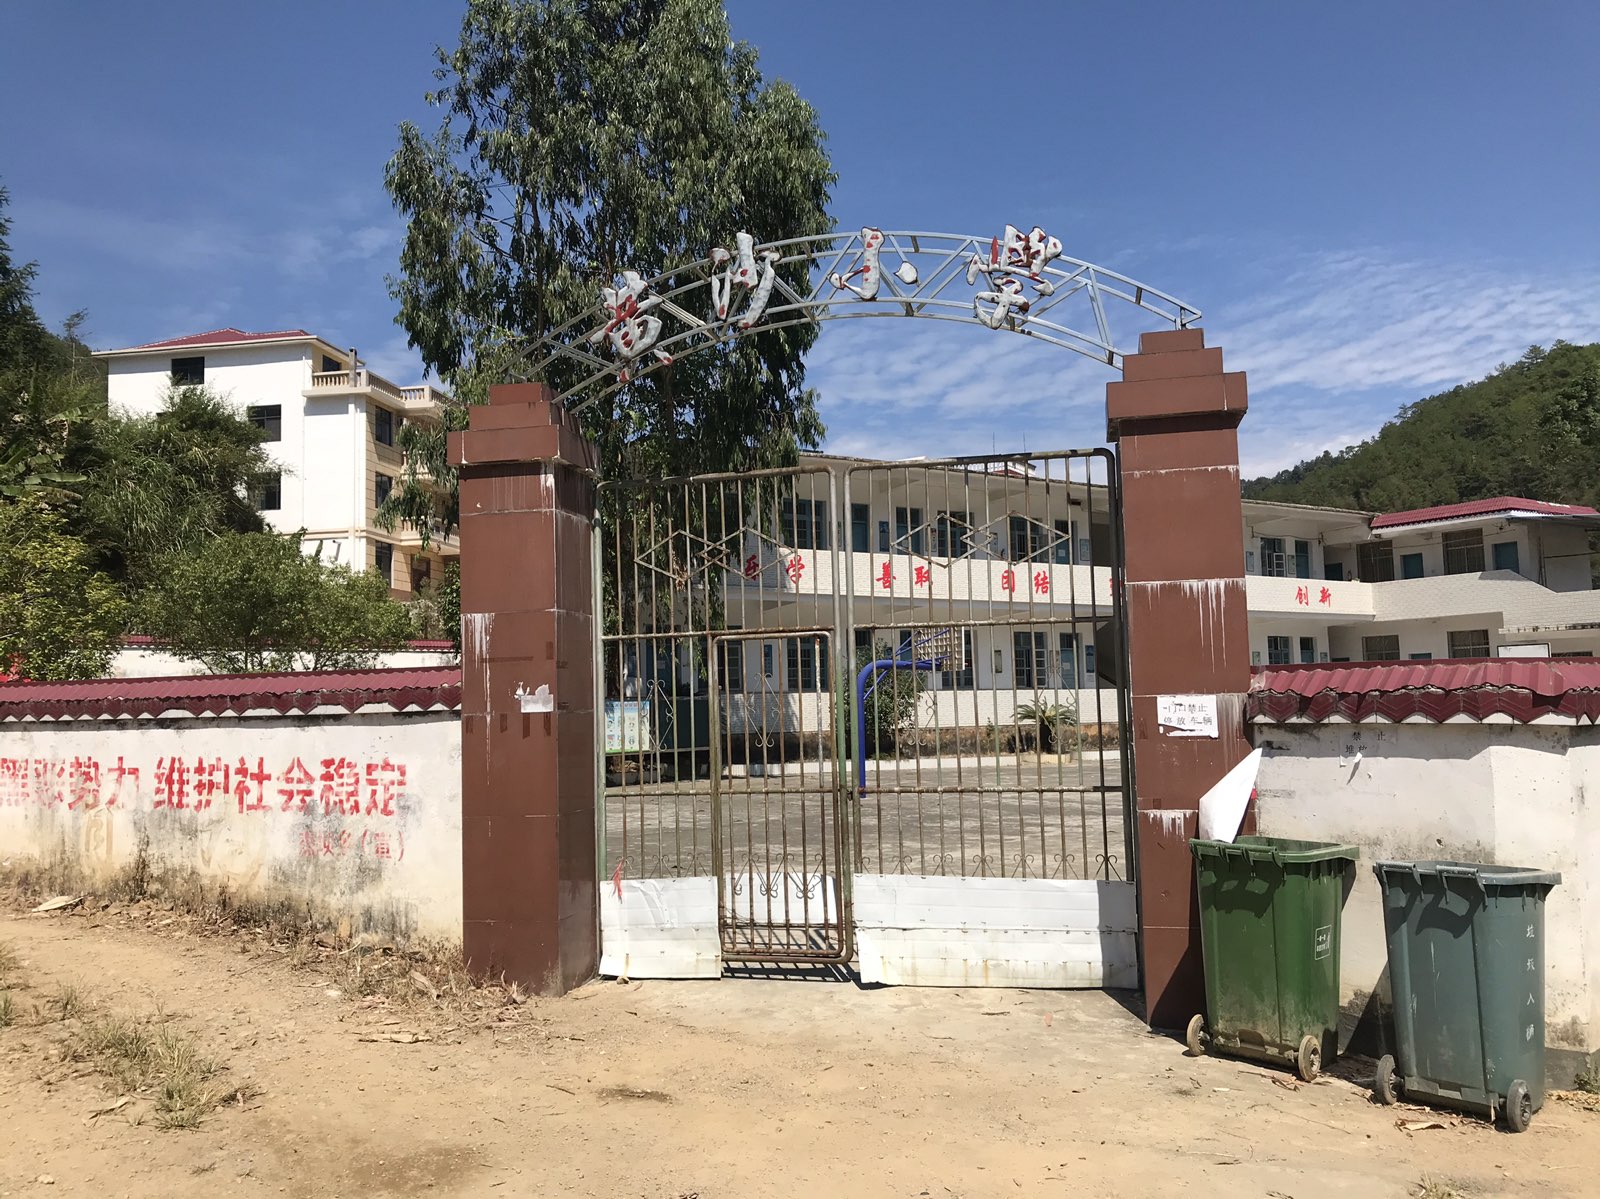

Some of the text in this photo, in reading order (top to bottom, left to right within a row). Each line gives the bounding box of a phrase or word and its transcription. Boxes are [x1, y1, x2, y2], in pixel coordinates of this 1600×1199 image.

[1002, 569, 1050, 595] 团结
[1295, 585, 1333, 608] 创新
[1352, 731, 1387, 742] 禁止
[153, 756, 407, 817] 维护社会稳定
